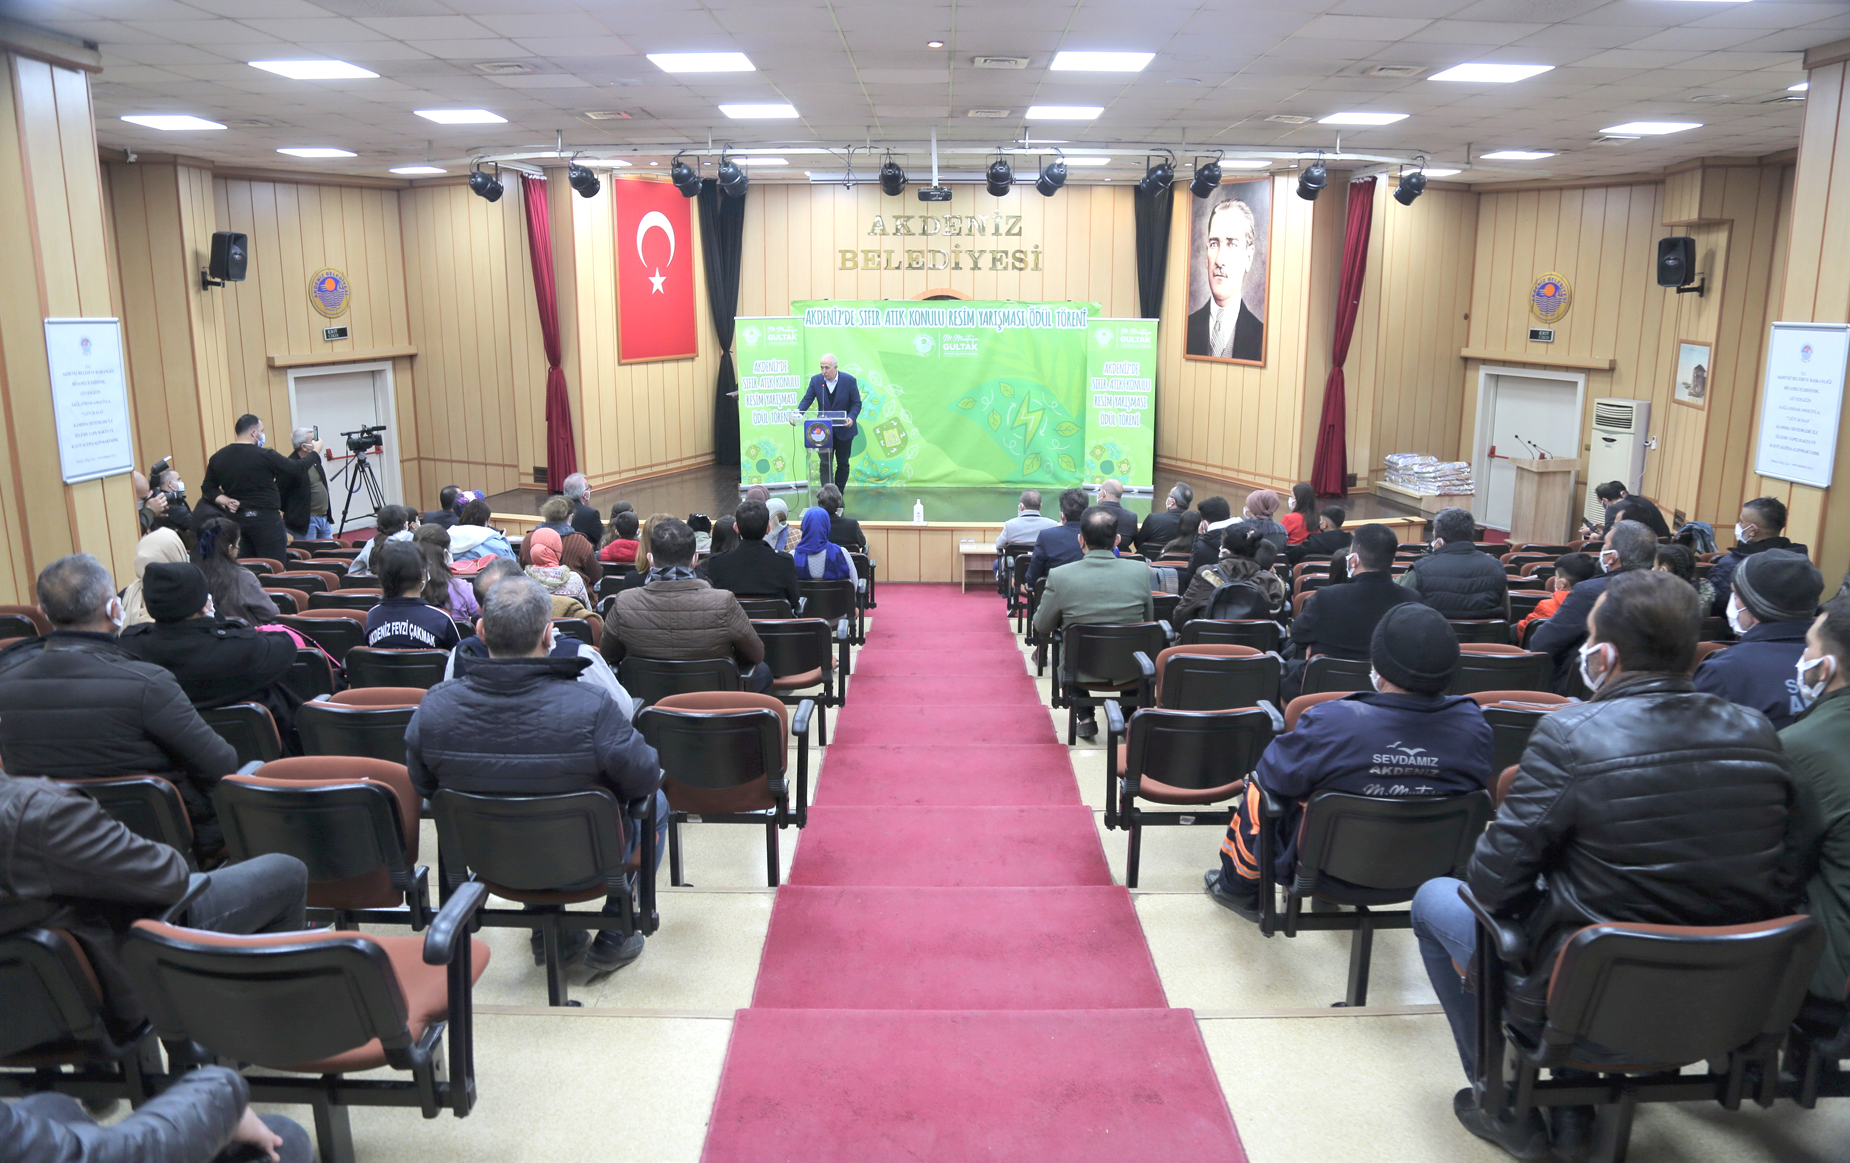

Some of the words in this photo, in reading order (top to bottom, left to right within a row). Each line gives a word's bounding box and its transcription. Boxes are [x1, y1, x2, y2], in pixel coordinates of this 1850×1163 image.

[868, 209, 1022, 236] AKDENİZ
[838, 244, 1042, 271] BELEDİYESİ
[859, 310, 881, 326] SIFIR
[884, 310, 905, 326] ATIK
[908, 310, 944, 326] KONULU
[948, 308, 975, 326] RESİM
[978, 310, 1025, 330] YARIŞMASI
[1029, 308, 1052, 327] ÖDÜL
[1056, 308, 1086, 327] TÖRENİ
[742, 378, 758, 389] SIFIR
[760, 377, 774, 388] ATIK
[776, 376, 799, 388] KONULU
[1092, 378, 1107, 389] SIFIR
[1110, 379, 1124, 390] ATIK
[1126, 380, 1151, 391] KONULU
[746, 393, 764, 406] RESİM
[766, 393, 797, 408] YARIŞMASI
[1095, 394, 1112, 407] RESİM
[1115, 396, 1147, 410] YARIŞMASI
[753, 411, 768, 424] ÖDÜL
[1100, 412, 1116, 425] ÖDÜL
[1119, 413, 1140, 426] TÖRENİ
[392, 620, 408, 635] FEVZİ
[409, 624, 436, 647] ÇAKMAK
[1372, 754, 1439, 766] SEVDAMIZ
